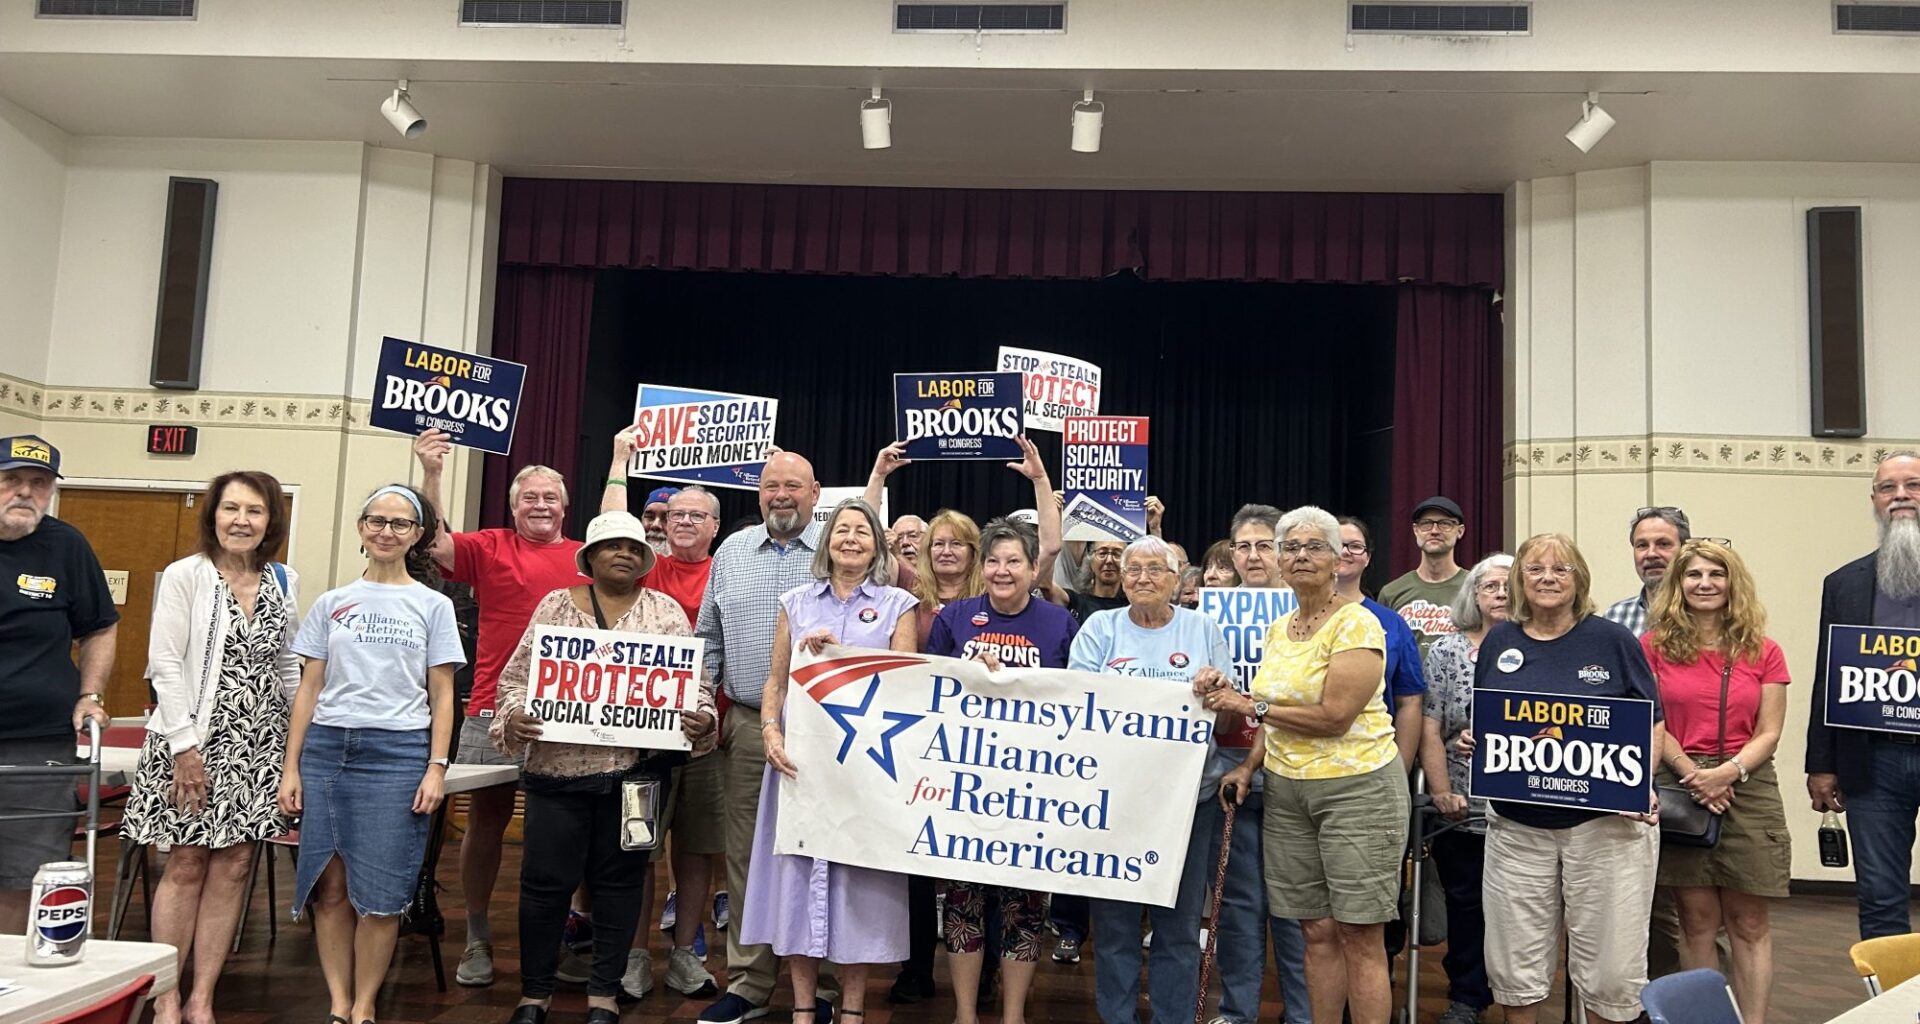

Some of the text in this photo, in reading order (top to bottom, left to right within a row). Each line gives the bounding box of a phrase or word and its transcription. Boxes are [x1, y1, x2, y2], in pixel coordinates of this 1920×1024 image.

[404, 347, 493, 382] LABOR FOR
[1003, 354, 1039, 372] STOP
[1050, 361, 1098, 386] STEAL!!
[918, 379, 994, 398] LABOR FOR
[1023, 373, 1098, 410] OTECT
[382, 374, 510, 432] BROOKS
[426, 416, 465, 434] CONGRESS
[636, 401, 771, 449] SAVE SOCIAL
[696, 422, 771, 444] SECURITY.
[905, 406, 1019, 440] BROOKS
[1068, 420, 1138, 442] PROTECT
[152, 428, 187, 452] EXIT
[948, 438, 982, 448] CONGRESS
[13, 450, 49, 461] SOAR
[634, 440, 770, 470] IT'S OUR MONEY!
[1066, 445, 1123, 467] SOCIAL
[1066, 468, 1145, 491] SECURITY.
[108, 577, 125, 586] EXIT
[358, 613, 410, 627] Alliance
[1203, 591, 1298, 625] EXPAN
[1400, 606, 1450, 621] Better
[353, 633, 420, 649] Americans
[366, 623, 413, 638] Retired
[980, 632, 1026, 647] UNION
[540, 635, 695, 669] STOP THE STEAL!!
[961, 640, 1041, 668] STRONG
[1860, 633, 1920, 657] LABO
[535, 658, 694, 710] PROTECT
[1139, 667, 1186, 677] Alliance
[1578, 670, 1610, 680] BROOKS
[1839, 665, 1920, 703] BRO
[530, 699, 594, 725] SOCIAL
[926, 675, 1213, 745] Pennsylvania
[1504, 699, 1610, 727] LABOR FOR
[1896, 705, 1920, 720] CONG
[919, 723, 1098, 780] Alliance
[1484, 733, 1643, 787] BROOKS
[1528, 776, 1589, 794] FOR CONGRESS
[906, 770, 1111, 831] for Retired
[38, 906, 87, 921] PEPSI
